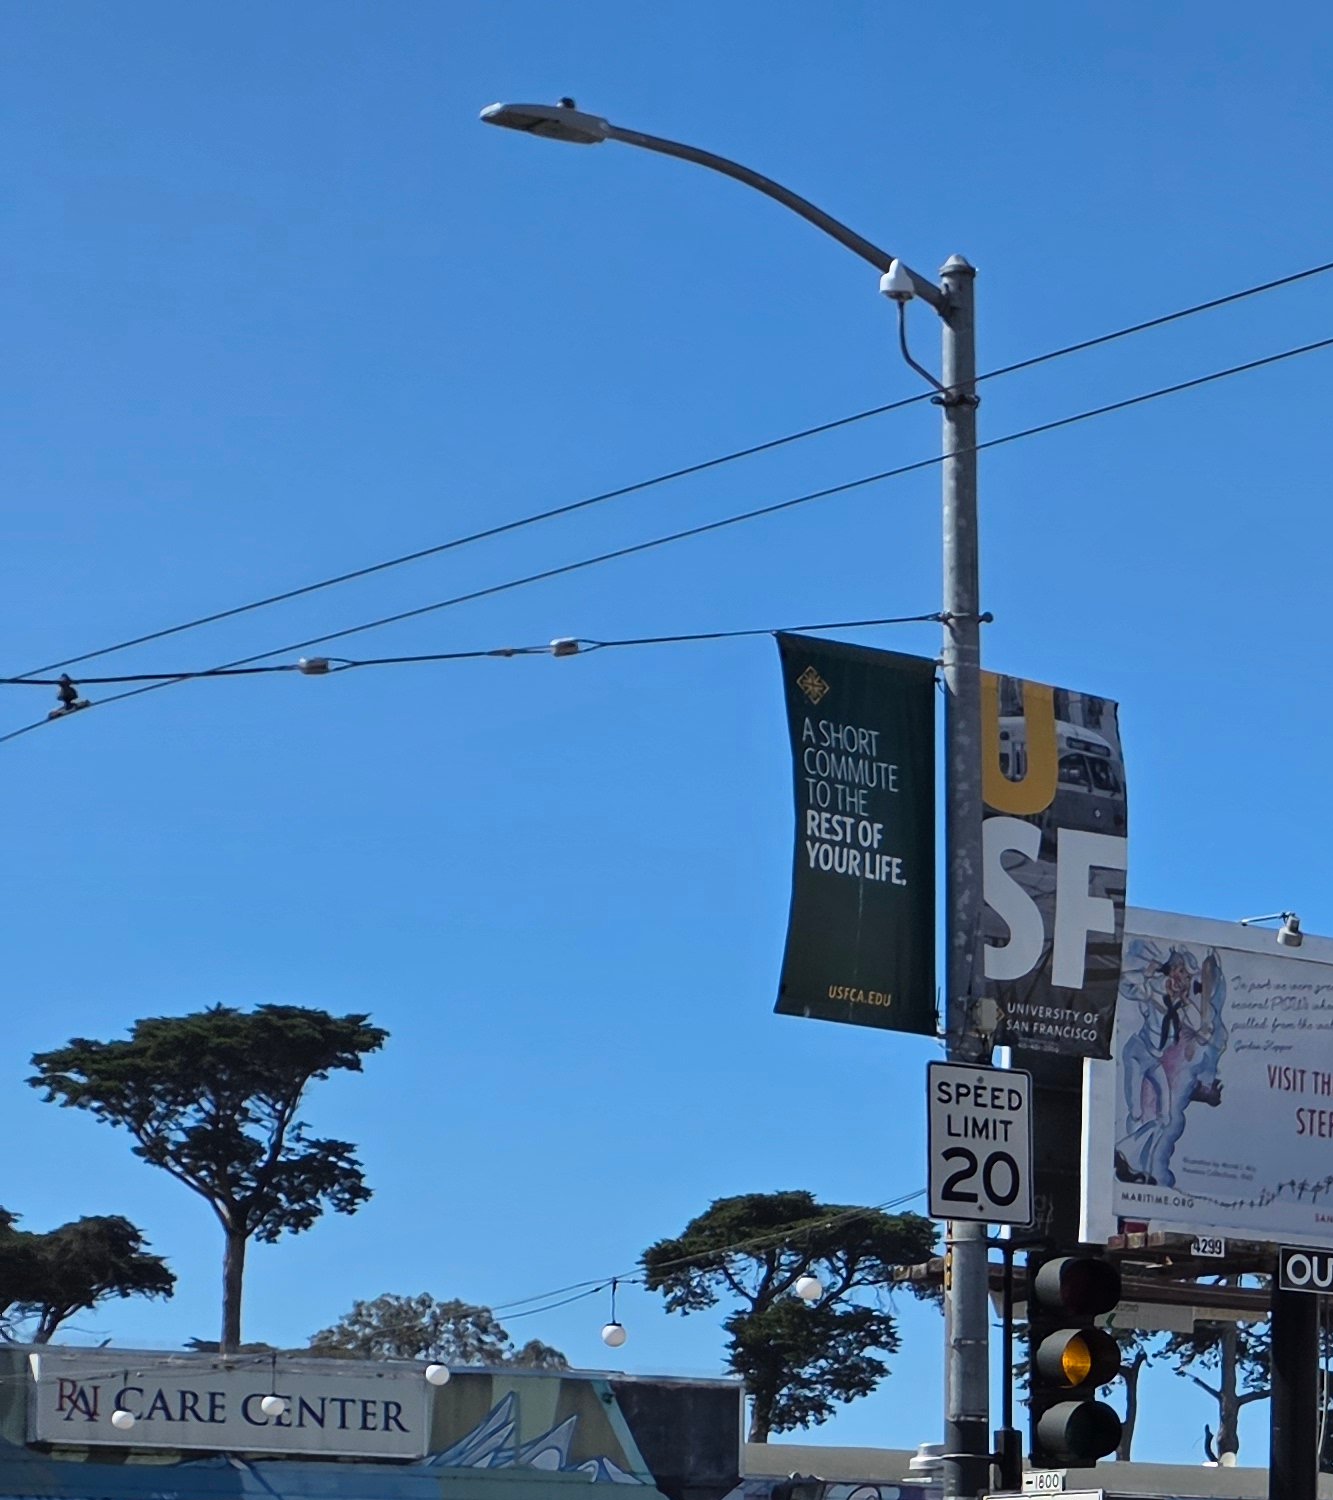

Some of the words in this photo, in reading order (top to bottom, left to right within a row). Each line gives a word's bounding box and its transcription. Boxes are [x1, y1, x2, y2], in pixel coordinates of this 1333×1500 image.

[802, 717, 816, 744] A
[818, 719, 881, 757] SHORT
[803, 747, 899, 792] COMMUTE
[804, 777, 831, 808] TO
[834, 783, 869, 817] THE
[806, 809, 855, 844] REST
[857, 820, 884, 849] OF
[805, 840, 861, 877] YOUR
[864, 851, 907, 887] LIFE.
[982, 816, 1127, 990] SF
[828, 983, 892, 1008] USFCA.EDU
[1007, 1001, 1080, 1022] UNIVERSITY
[1083, 1011, 1100, 1025] OF
[1005, 1018, 1029, 1033] SAN
[1032, 1021, 1098, 1042] FRANCISCO
[936, 1081, 1024, 1112] SPEED
[1267, 1064, 1307, 1094] VISIT
[946, 1113, 1014, 1143] LIMIT
[940, 1146, 1021, 1207] 20
[1121, 1191, 1195, 1209] MARITIME.ORG
[113, 1386, 227, 1425] CARE
[240, 1393, 411, 1434] CENTER
[1034, 1474, 1060, 1490] 1800
